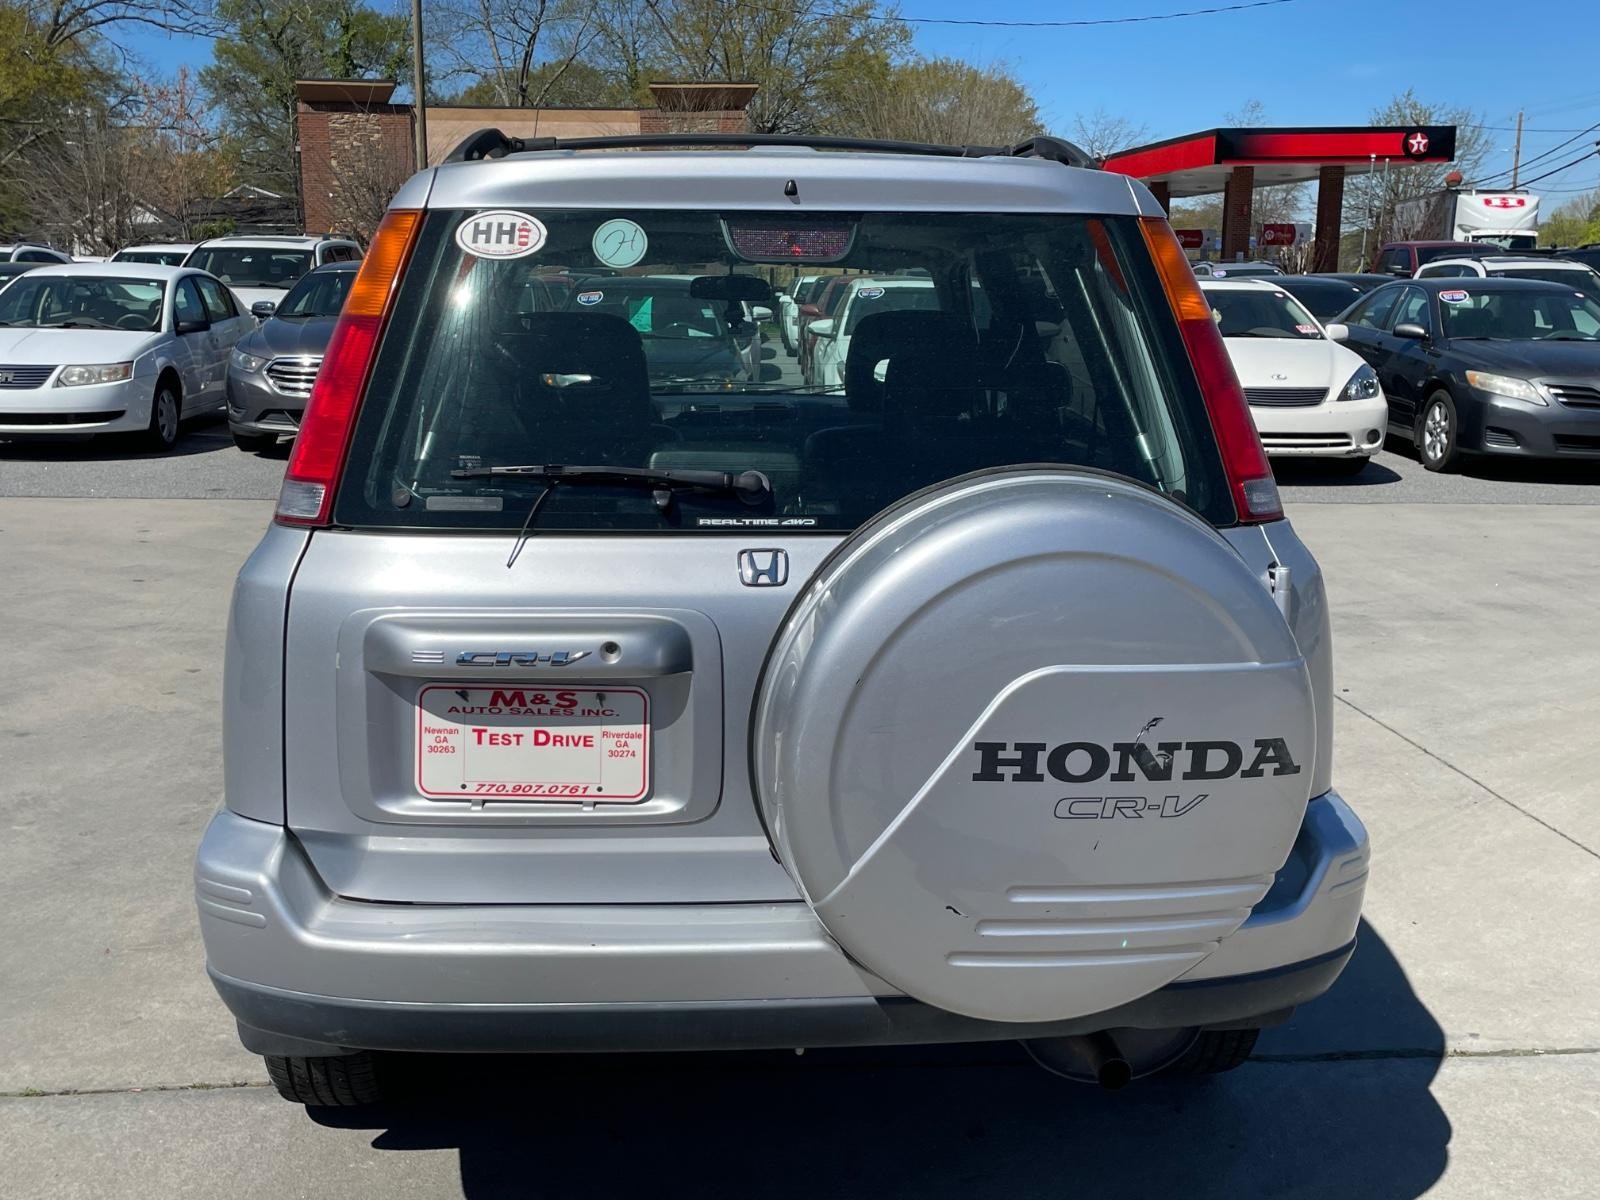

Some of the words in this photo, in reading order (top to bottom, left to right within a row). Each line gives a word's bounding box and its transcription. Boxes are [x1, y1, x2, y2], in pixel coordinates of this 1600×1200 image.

[781, 518, 816, 526] 4WD
[456, 651, 593, 667] CR-V
[448, 706, 504, 715] AUTO
[508, 707, 575, 716] SALES
[581, 708, 620, 717] INC.
[424, 726, 459, 735] Newnan
[602, 730, 643, 740] Riverdale
[434, 736, 449, 745] GA
[615, 740, 629, 749] GA
[427, 745, 456, 754] 30263
[608, 750, 636, 758] 30274
[972, 737, 1301, 784] HONDA
[475, 783, 590, 795] 770.907.0761
[1053, 794, 1209, 819] CR-V
